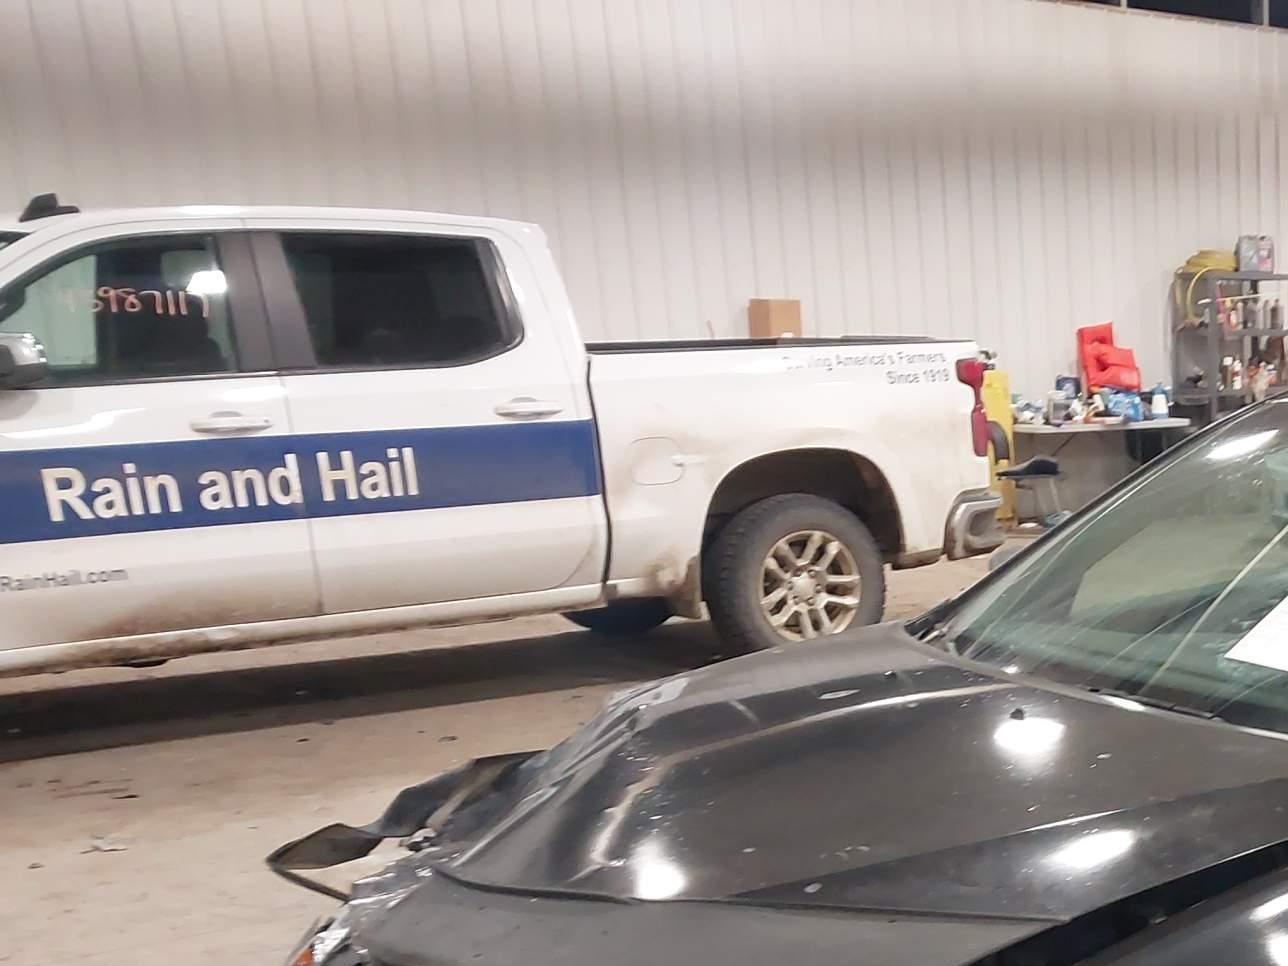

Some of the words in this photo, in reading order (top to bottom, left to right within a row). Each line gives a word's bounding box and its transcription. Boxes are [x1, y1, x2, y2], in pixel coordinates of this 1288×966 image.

[898, 351, 946, 364] Farmers
[886, 371, 920, 384] Since
[922, 368, 949, 382] 1919
[40, 463, 183, 522] Rain
[198, 453, 304, 510] and
[316, 447, 419, 501] Hail
